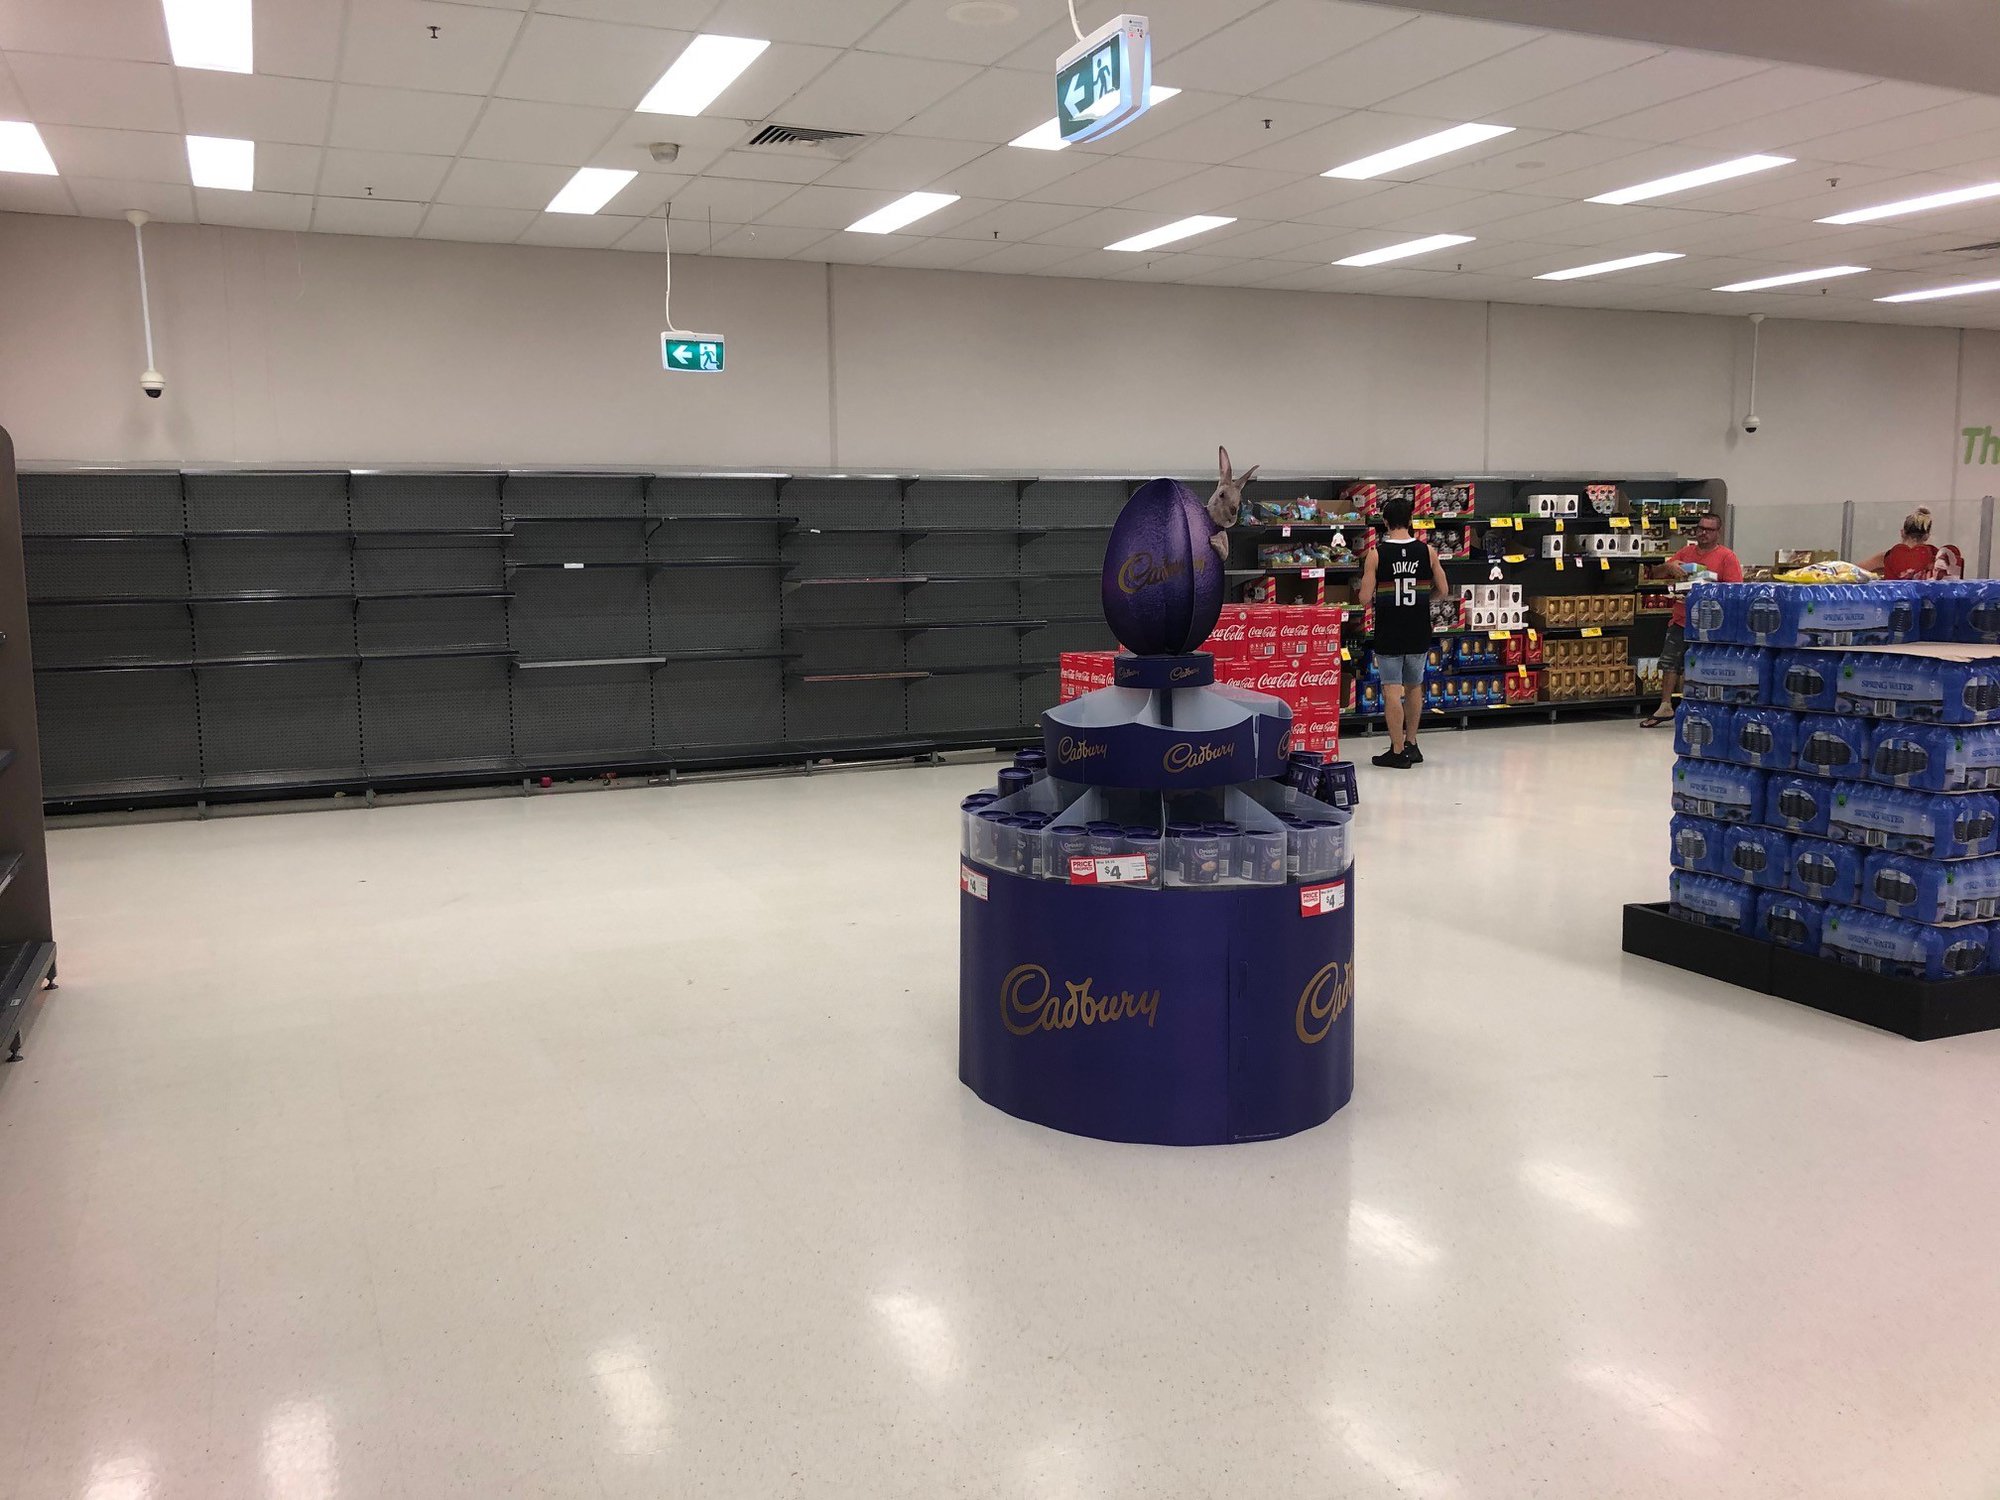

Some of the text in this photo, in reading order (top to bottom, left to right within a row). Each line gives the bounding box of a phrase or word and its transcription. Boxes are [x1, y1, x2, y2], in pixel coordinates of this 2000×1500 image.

[1392, 560, 1419, 575] JOKIĆ
[1394, 577, 1417, 607] 15
[1861, 680, 1914, 691] SPRING WATER
[1057, 735, 1108, 765] Cadbury
[1163, 742, 1236, 774] Cadbury
[1104, 865, 1122, 879] $4
[1326, 894, 1335, 908] $4
[1000, 964, 1160, 1035] Cadbury
